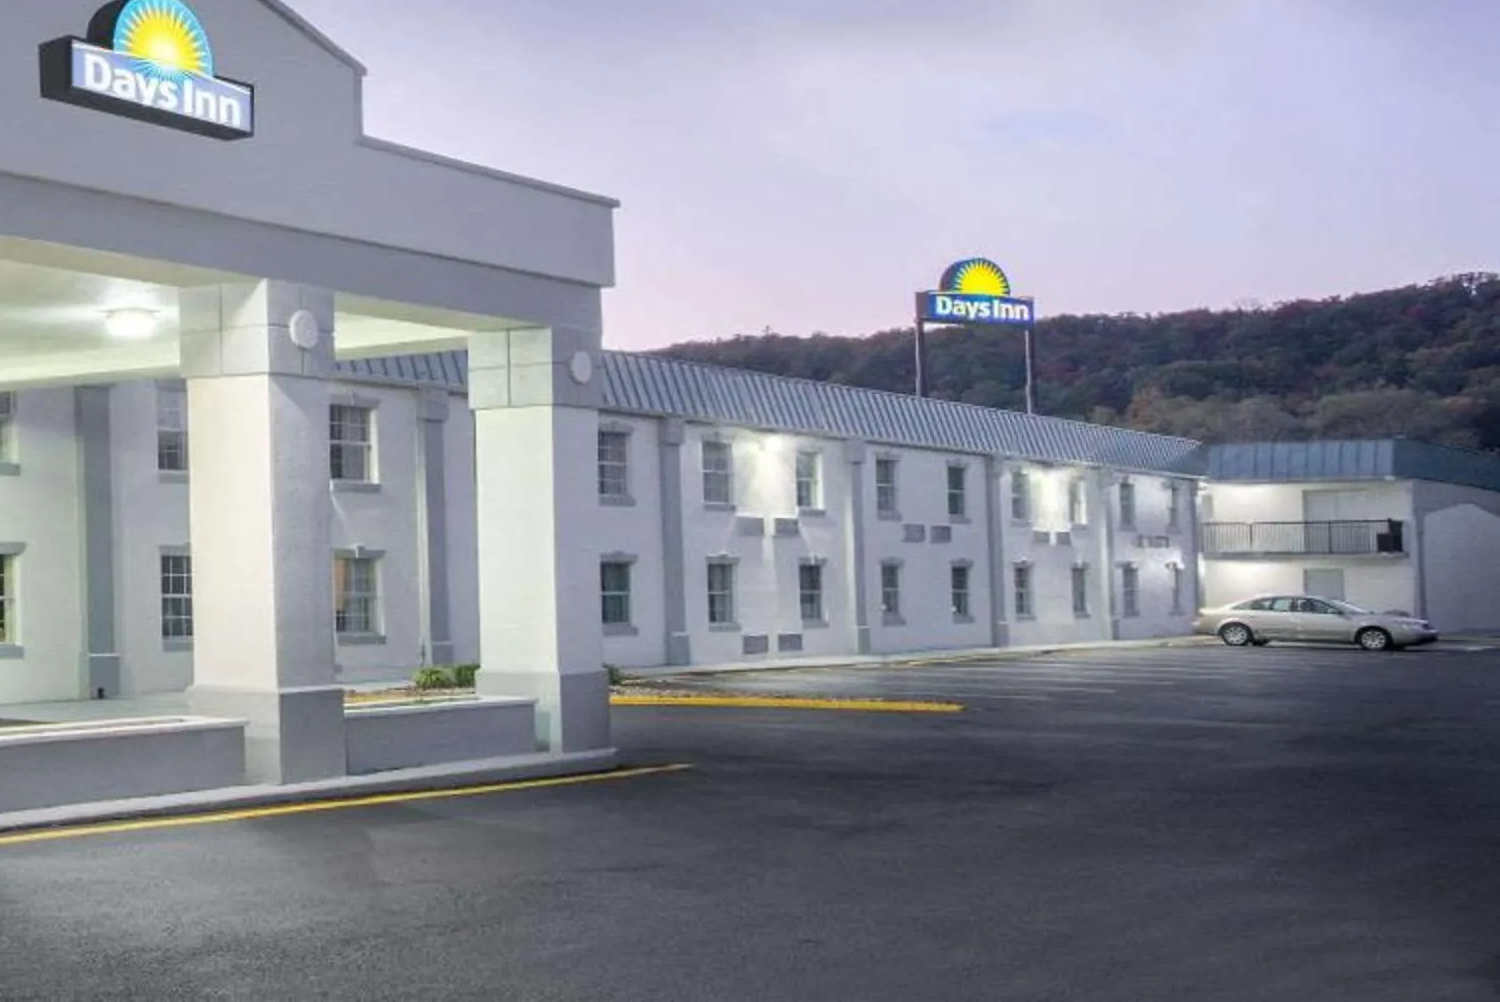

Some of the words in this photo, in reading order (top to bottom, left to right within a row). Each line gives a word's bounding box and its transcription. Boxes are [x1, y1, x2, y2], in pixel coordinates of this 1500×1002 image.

[84, 53, 178, 111] Days
[183, 79, 241, 128] Inn
[935, 295, 991, 319] Days
[993, 299, 1029, 320] Inn
